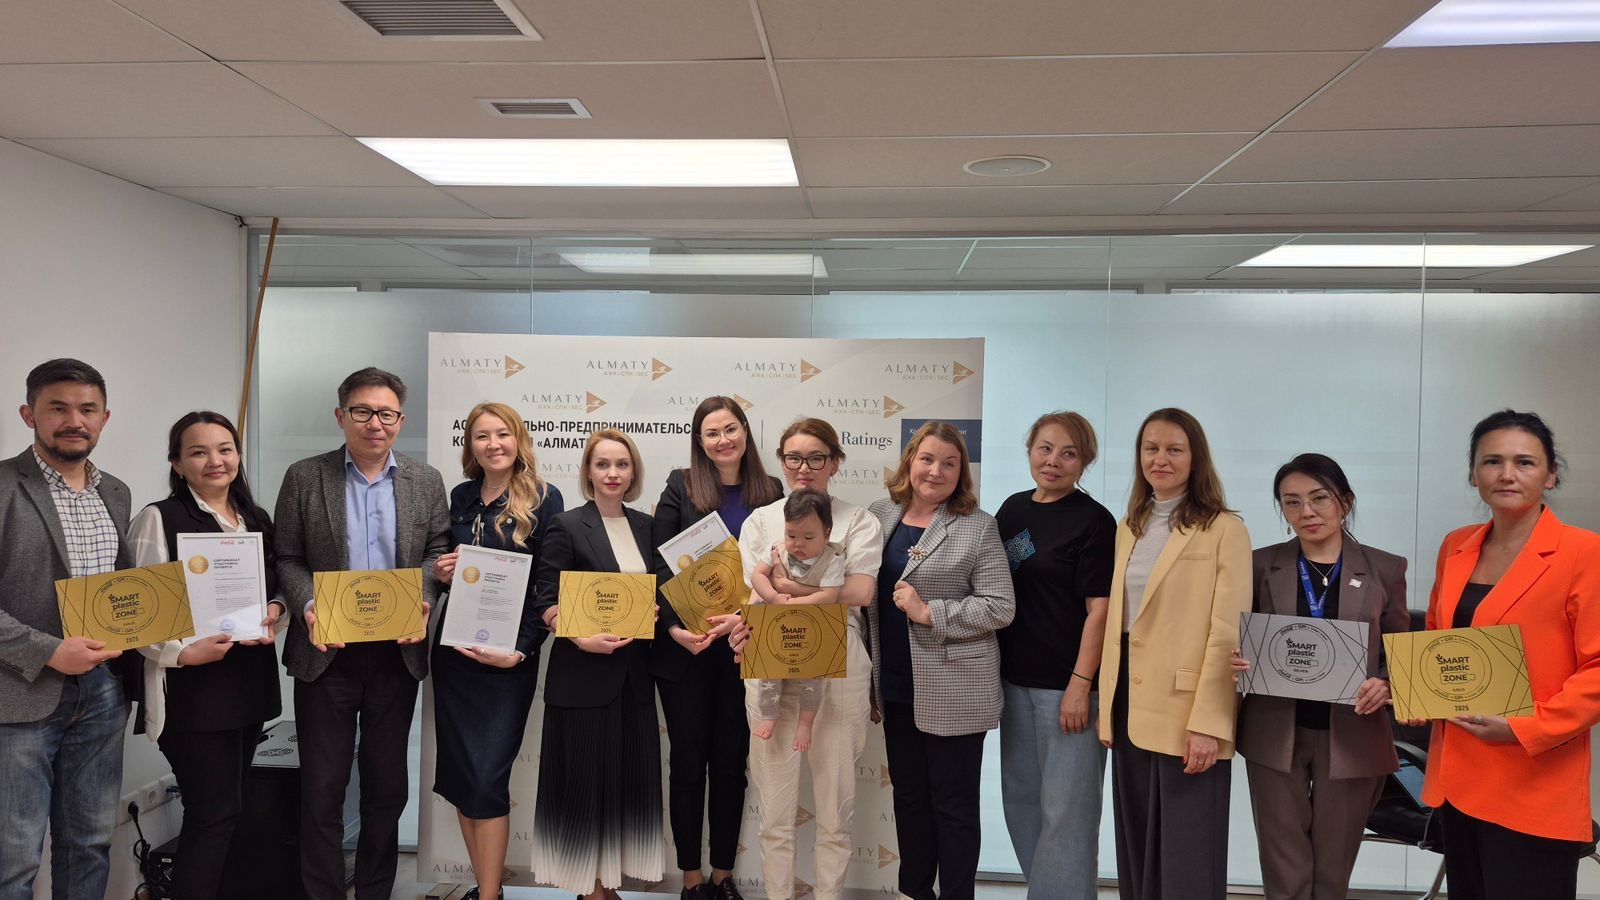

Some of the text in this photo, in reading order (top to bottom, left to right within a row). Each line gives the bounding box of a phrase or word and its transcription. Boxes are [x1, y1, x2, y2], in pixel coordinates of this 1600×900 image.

[440, 358, 501, 368] ALMATY
[586, 360, 649, 370] ALMATY
[734, 362, 797, 372] ALMATY
[884, 363, 950, 374] ALMATY
[521, 394, 583, 403] ALMATY
[667, 395, 699, 406] ALM
[816, 398, 880, 408] ALMATY
[537, 437, 588, 449] «АЛМАТ
[841, 431, 893, 450] Ratings
[837, 469, 880, 479] MATY
[701, 571, 719, 586] SMART
[110, 593, 140, 604] SMART
[357, 597, 381, 606] plastic
[112, 600, 140, 611] plastic
[115, 609, 138, 618] ZONE
[1286, 642, 1318, 650] SMART
[1288, 649, 1316, 657] plastic
[1437, 656, 1471, 664] SMART
[1440, 664, 1470, 673] plastic
[1443, 674, 1468, 682] ZONE
[433, 863, 474, 873] ALMA
